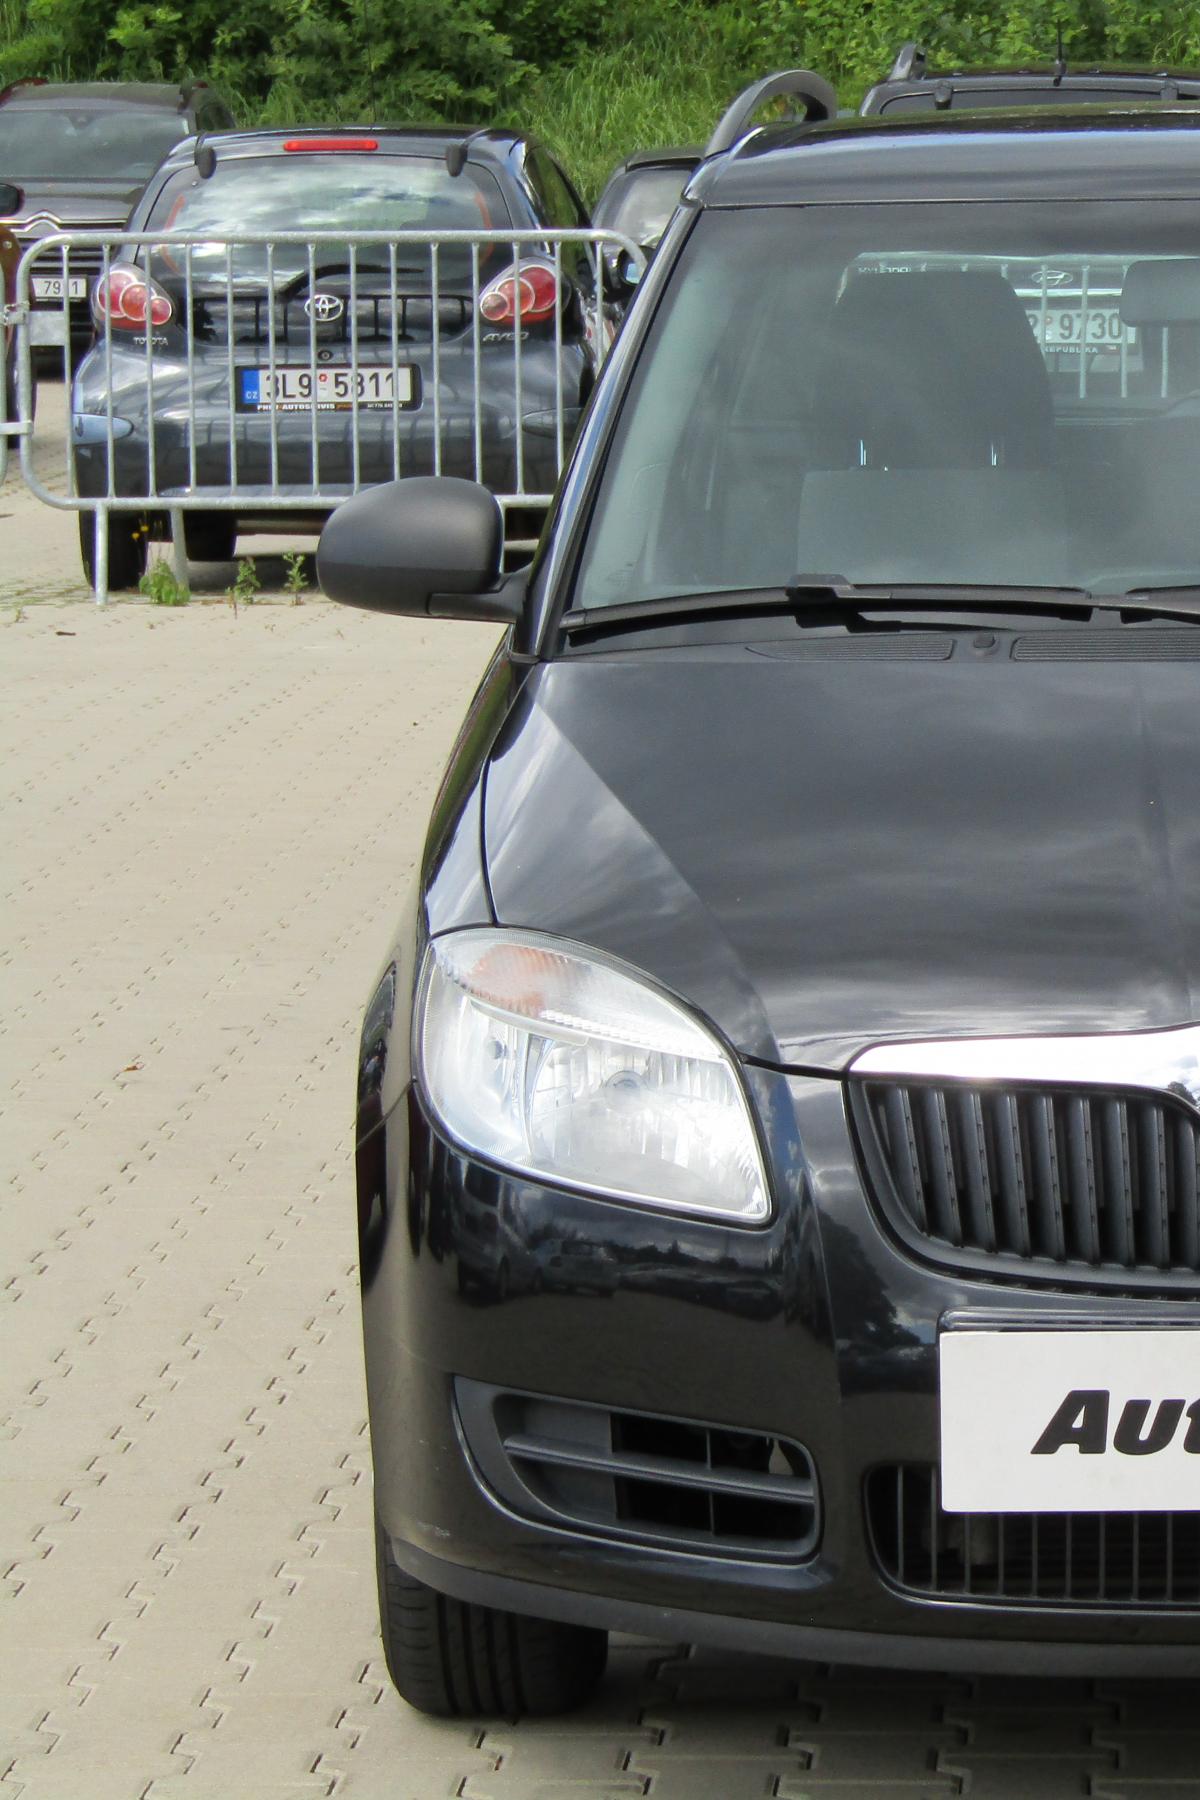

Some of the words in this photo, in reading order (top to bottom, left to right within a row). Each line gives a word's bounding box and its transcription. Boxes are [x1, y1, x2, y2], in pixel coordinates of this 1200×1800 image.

[44, 280, 78, 295] 791
[1059, 312, 1121, 340] 9730
[1043, 346, 1099, 354] REPUBLKA
[265, 373, 313, 399] 3L9
[334, 372, 395, 398] 5811
[246, 391, 258, 400] CZ
